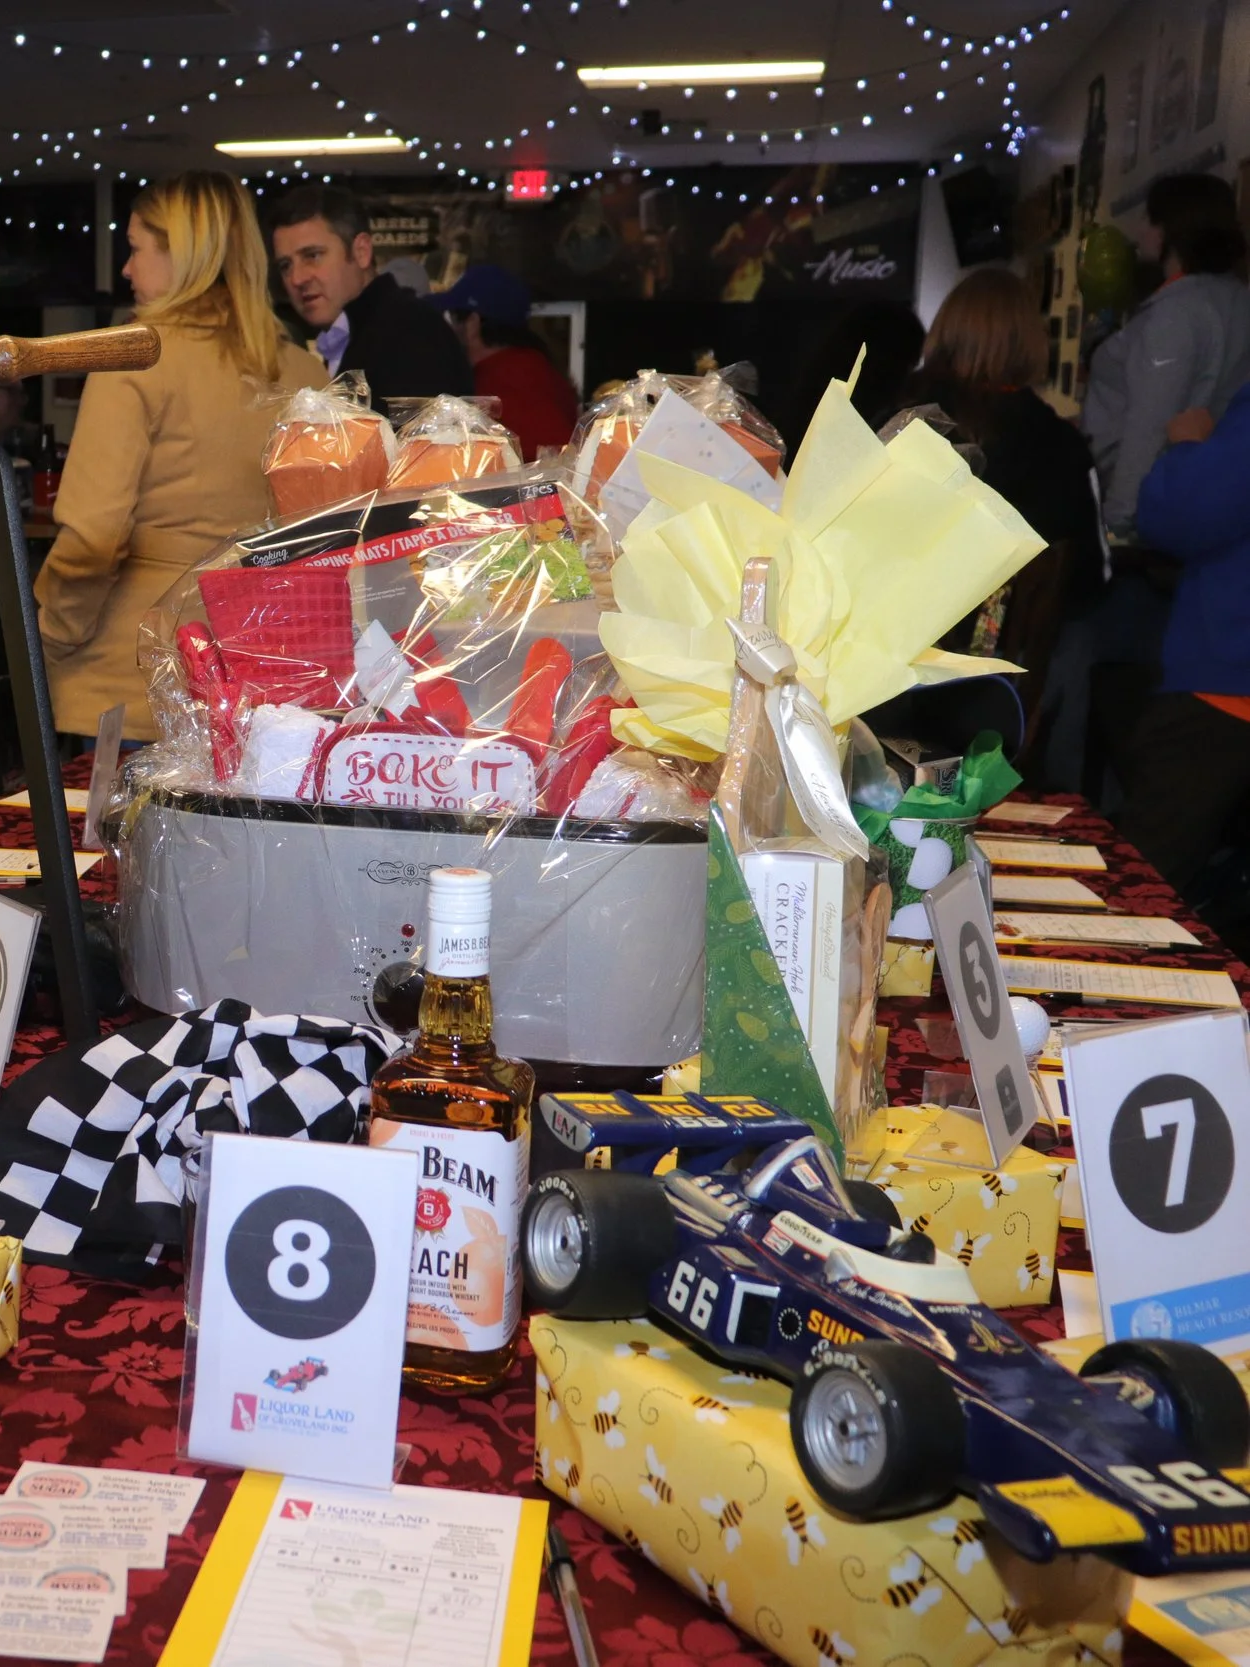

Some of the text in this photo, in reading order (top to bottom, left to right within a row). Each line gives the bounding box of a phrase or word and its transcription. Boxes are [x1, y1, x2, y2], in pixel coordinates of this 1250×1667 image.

[803, 247, 897, 285] Music
[250, 549, 289, 565] Cooking
[471, 760, 513, 792] IT
[792, 881, 808, 966] Mediterranean
[439, 937, 470, 954] JAMES
[965, 941, 993, 1018] 3
[672, 1116, 728, 1128] 66
[1140, 1097, 1196, 1207] 7
[422, 1145, 496, 1206] BEAM
[423, 1203, 435, 1216] B
[267, 1219, 330, 1301] 8
[428, 1289, 454, 1298] BOURBON
[454, 1293, 480, 1301] WHISKEY
[667, 1260, 719, 1330] 66
[1174, 1297, 1221, 1319] BILMAR
[1177, 1316, 1217, 1335] BEACH
[259, 1399, 355, 1422] LIQUOR LAND
[30, 1484, 78, 1496] SUGAR
[1107, 1461, 1250, 1509] 66
[316, 1504, 430, 1524] LIQUOR LAND
